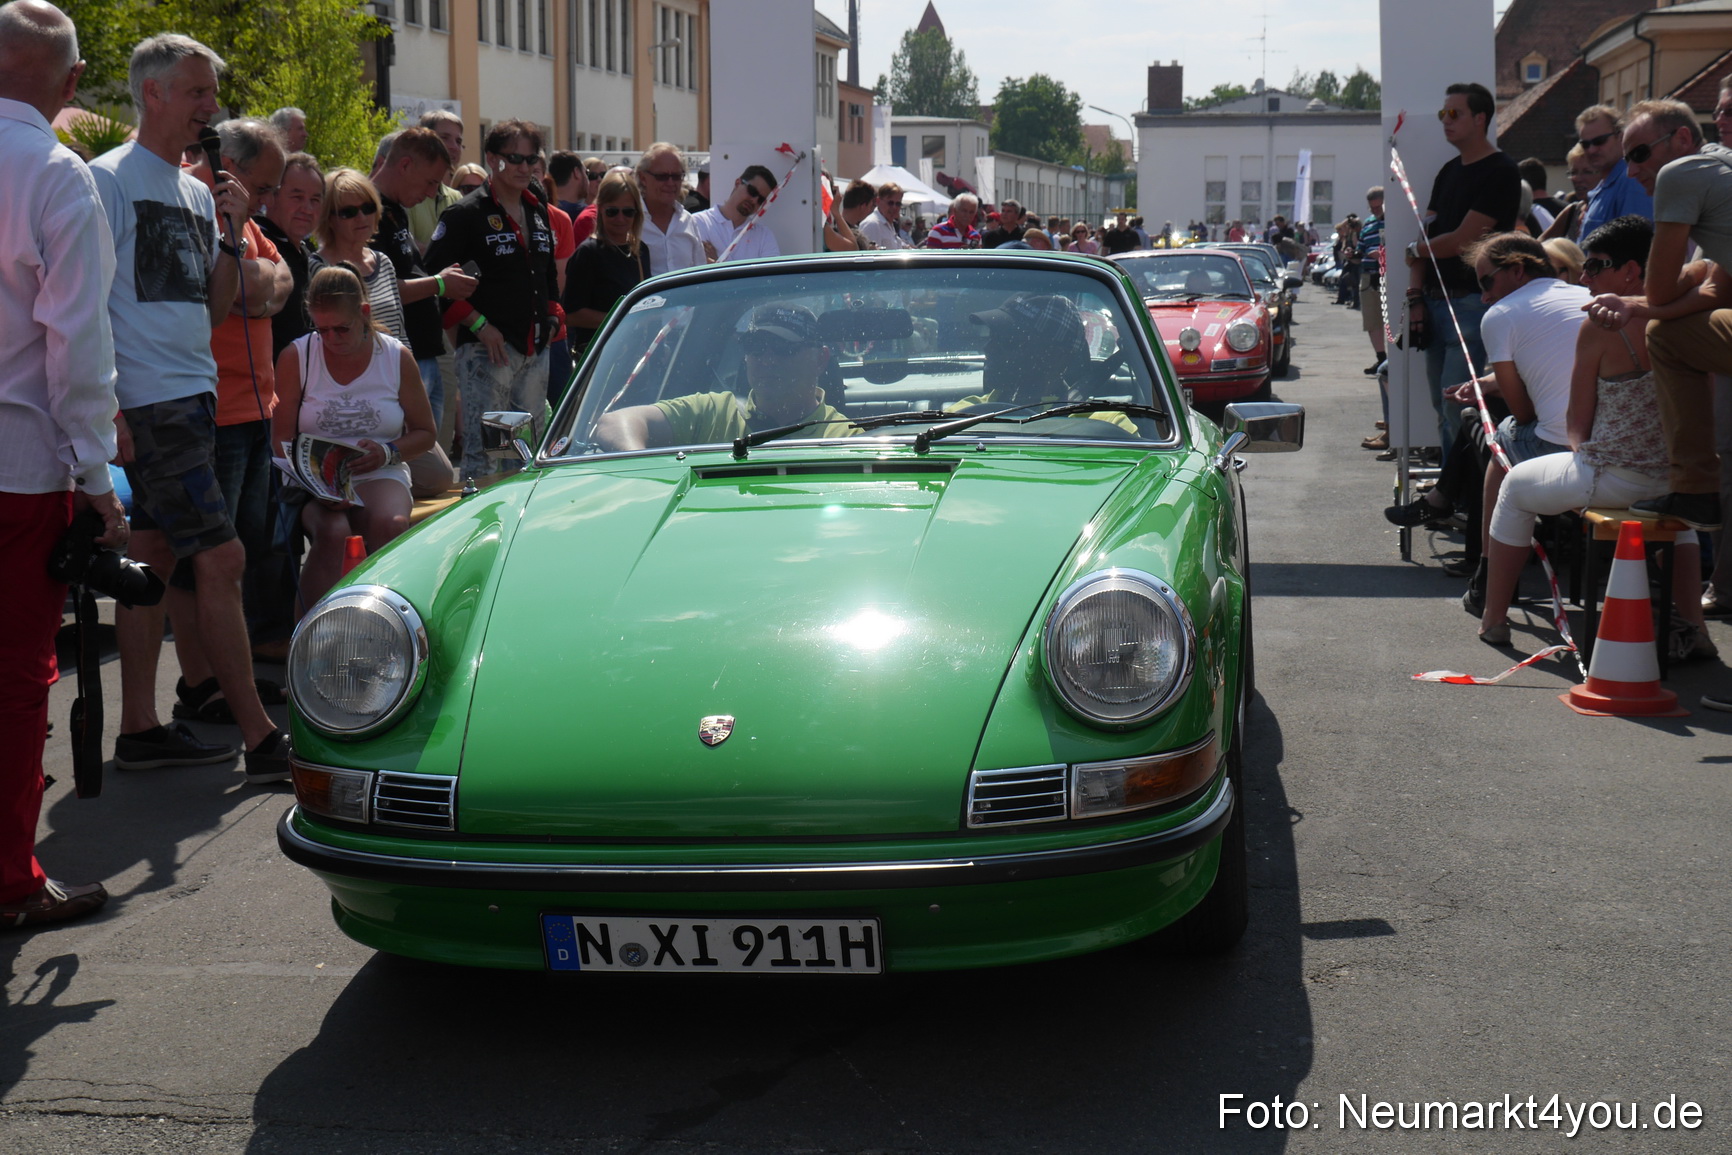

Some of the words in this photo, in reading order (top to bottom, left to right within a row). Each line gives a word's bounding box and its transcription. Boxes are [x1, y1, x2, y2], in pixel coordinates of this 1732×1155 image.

[485, 232, 517, 245] POR
[558, 949, 569, 961] D
[576, 923, 613, 965] N
[648, 924, 718, 966] XI
[732, 925, 876, 967] 911H
